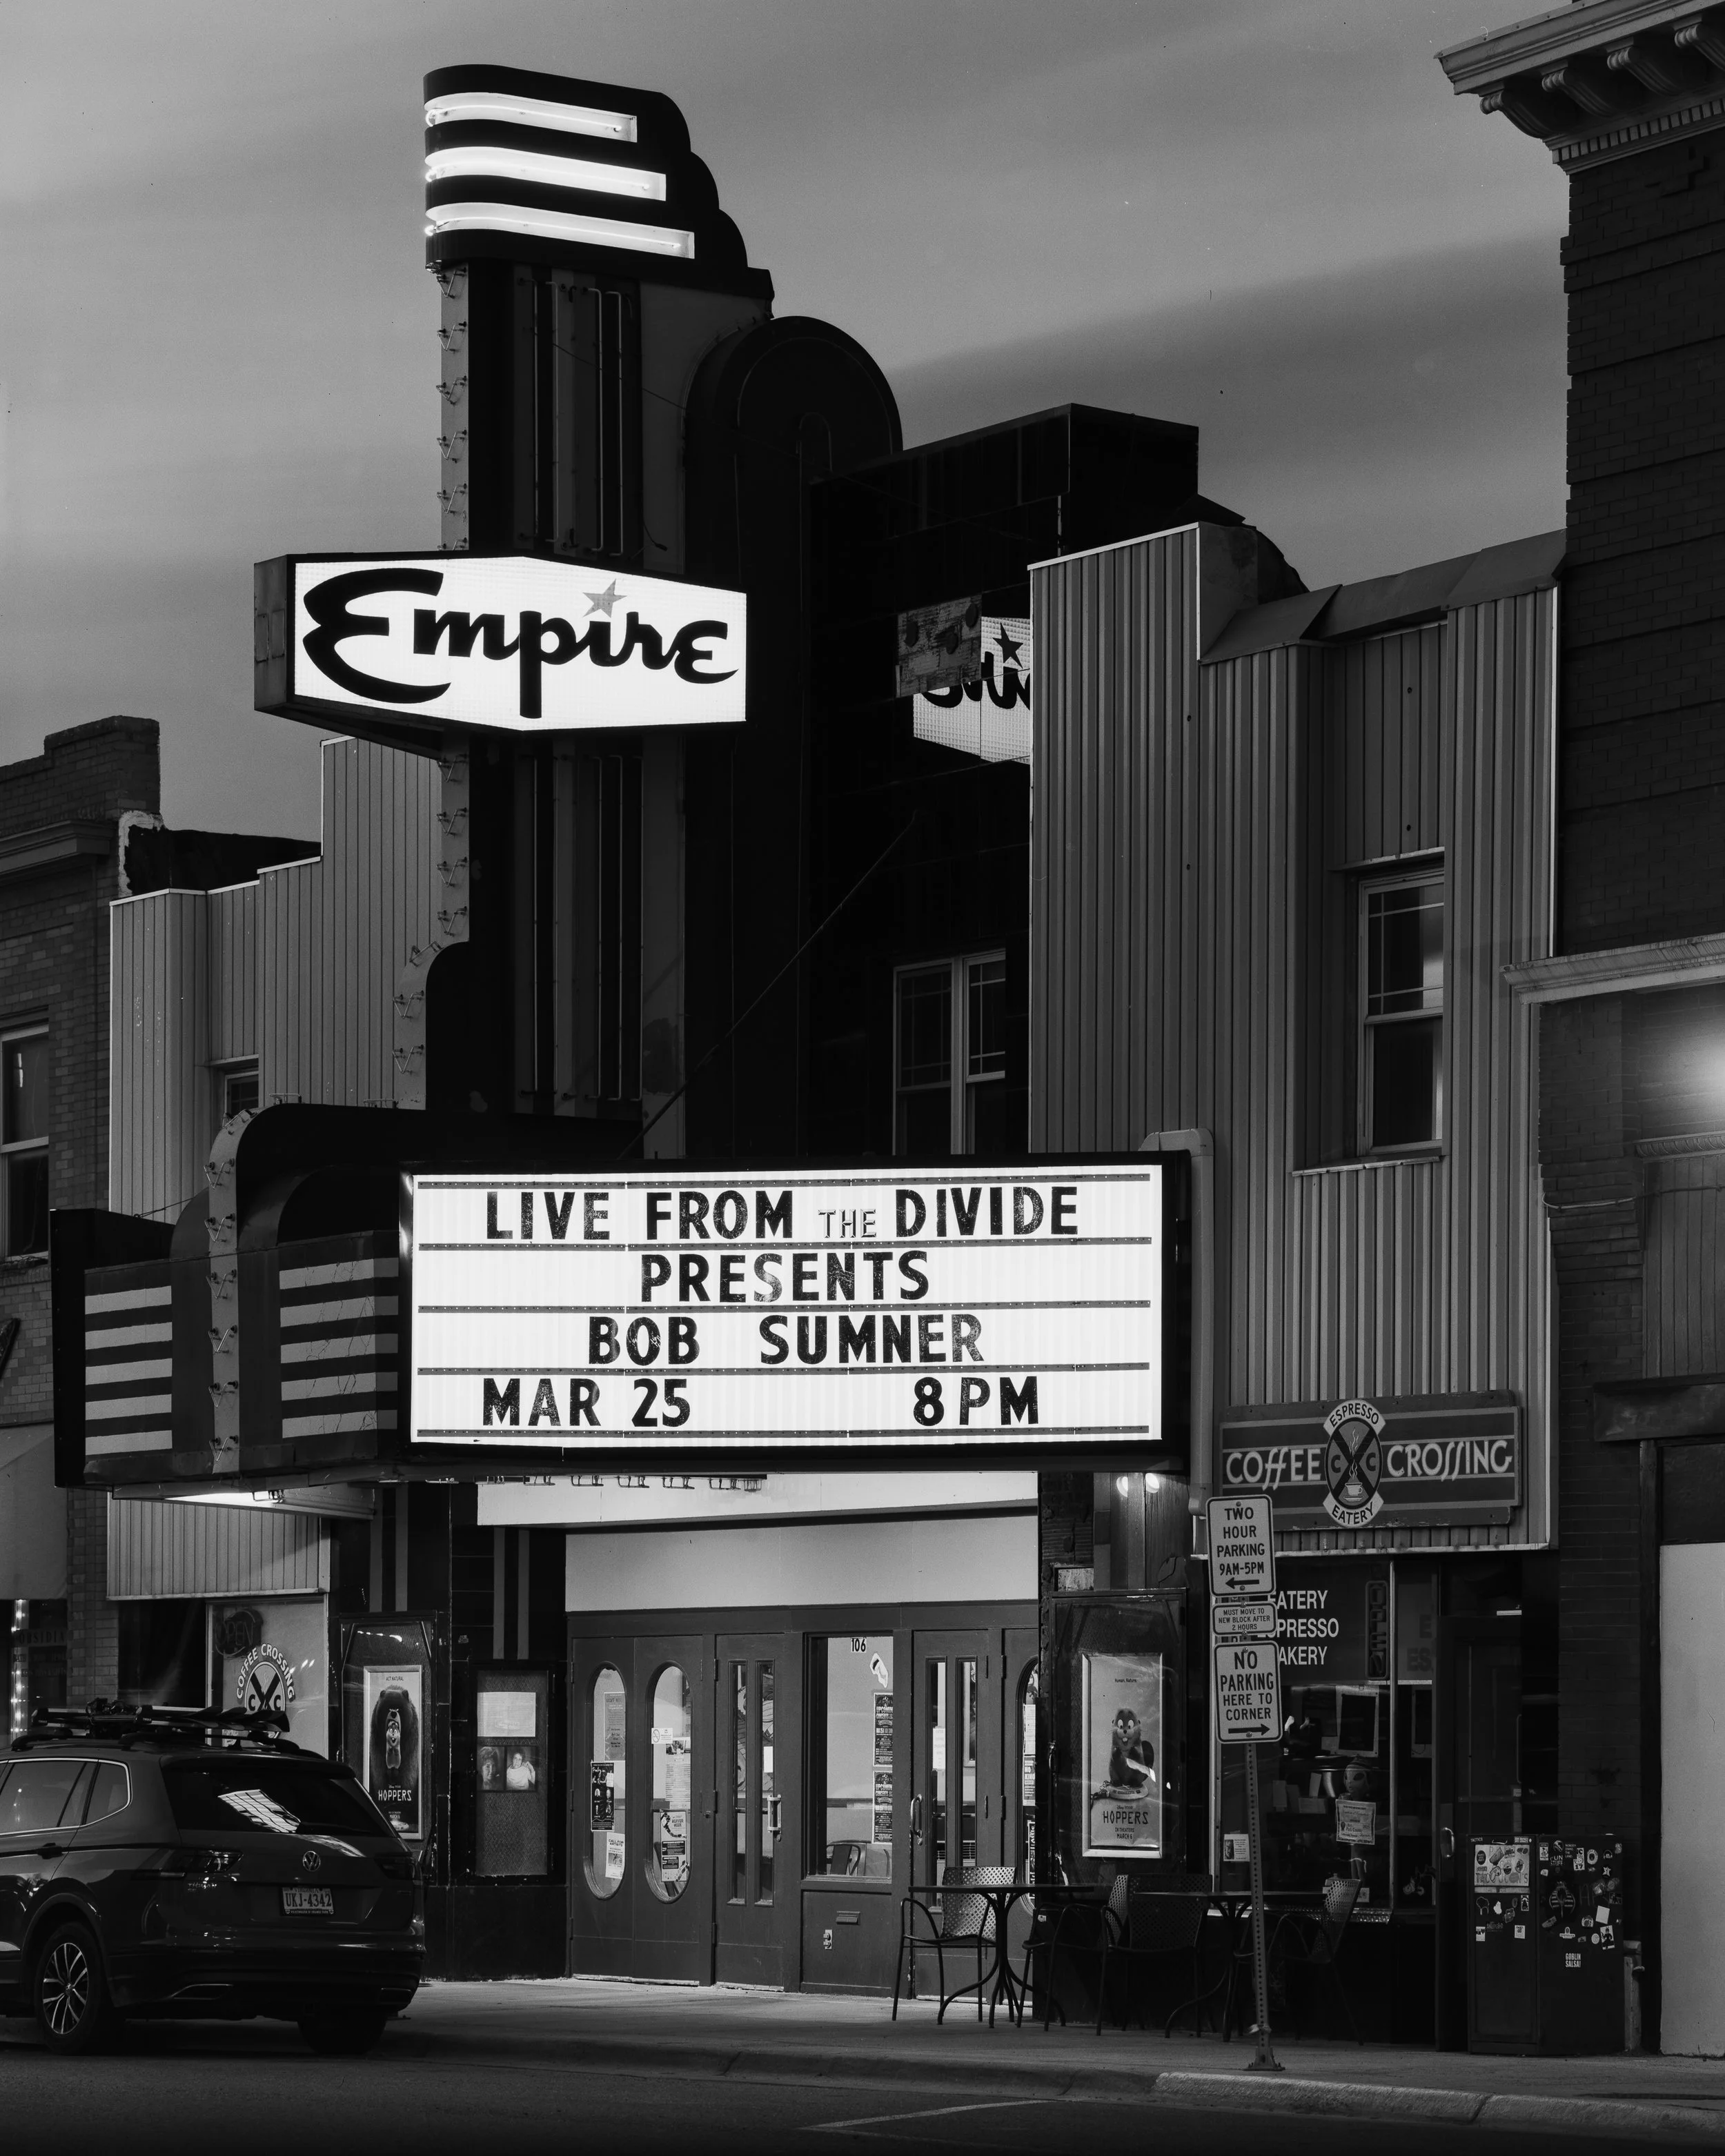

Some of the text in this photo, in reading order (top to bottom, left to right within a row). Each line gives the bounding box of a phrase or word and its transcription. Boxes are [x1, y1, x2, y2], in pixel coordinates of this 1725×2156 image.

[303, 567, 739, 719] Empire
[487, 1187, 1078, 1240] LIVE FROM THE DIVIDE
[641, 1252, 929, 1303] PRESENTS
[589, 1314, 985, 1365] BOB SUMNER
[483, 1378, 600, 1426] MAR
[632, 1378, 690, 1427] 25
[1330, 1403, 1379, 1427] ESPRESSO
[1226, 1440, 1513, 1491] COFFEE CROSSING
[1225, 1507, 1254, 1521] TWO
[1332, 1501, 1374, 1525] EATERY
[1223, 1525, 1256, 1539] HOUR
[1217, 1543, 1265, 1557] PARKING
[1219, 1561, 1265, 1576] 9AM-5PM
[19, 1630, 65, 1644] OBSIDIA
[1257, 1618, 1339, 1638] PRESSO
[851, 1638, 866, 1652] 106
[1234, 1650, 1258, 1670] NO
[1279, 1646, 1328, 1665] AKERY
[237, 1643, 295, 1699] COFFEE CROSSING
[1220, 1672, 1274, 1692] PARKING
[1223, 1693, 1272, 1706] HERE TO
[1226, 1708, 1272, 1721] CORNER
[378, 1789, 412, 1801] HOPPERS
[1103, 1810, 1148, 1824] HOPPERS
[286, 1892, 332, 1908] UKJ-4342
